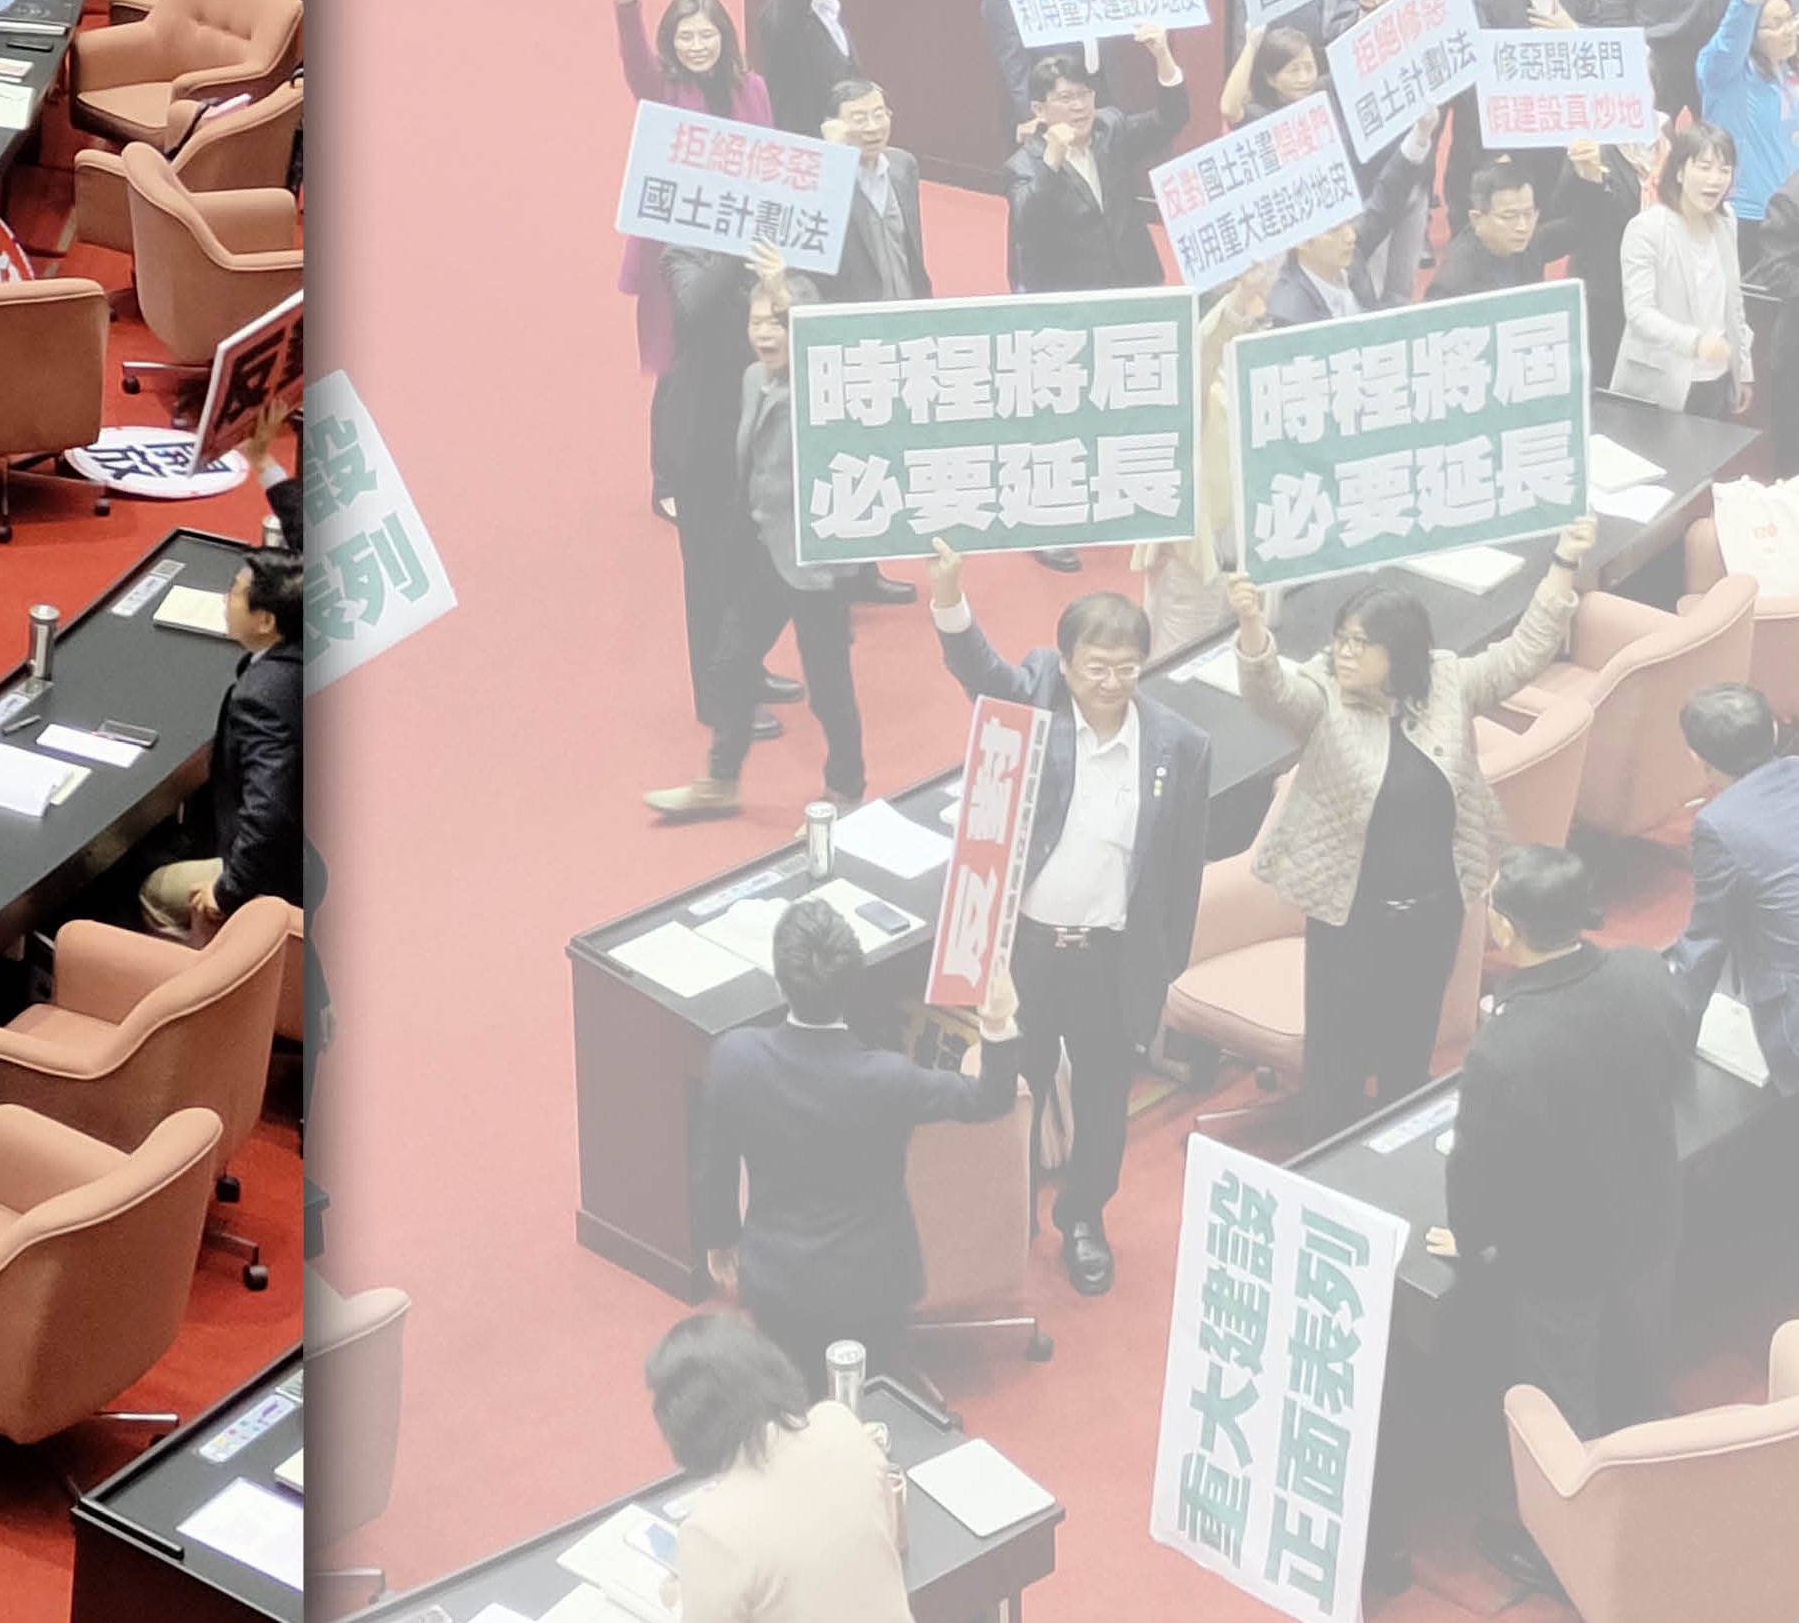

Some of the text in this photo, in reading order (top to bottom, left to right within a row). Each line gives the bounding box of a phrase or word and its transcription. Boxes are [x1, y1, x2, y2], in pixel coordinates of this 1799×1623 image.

[1355, 30, 1478, 141] 國土計劃法
[1485, 95, 1645, 134] 假建設真炒地
[1492, 41, 1625, 83] 修惡開後門
[669, 122, 823, 192] 拒絕修惡
[637, 176, 829, 255] 國土計劃法
[806, 322, 1179, 428] 時程將屆
[1251, 311, 1571, 448] 時程將屆
[810, 433, 1182, 539] 必要延長
[1255, 422, 1575, 562] 必要延長
[1178, 1168, 1278, 1568] 重大建設
[1263, 1206, 1371, 1615] 正面表列
